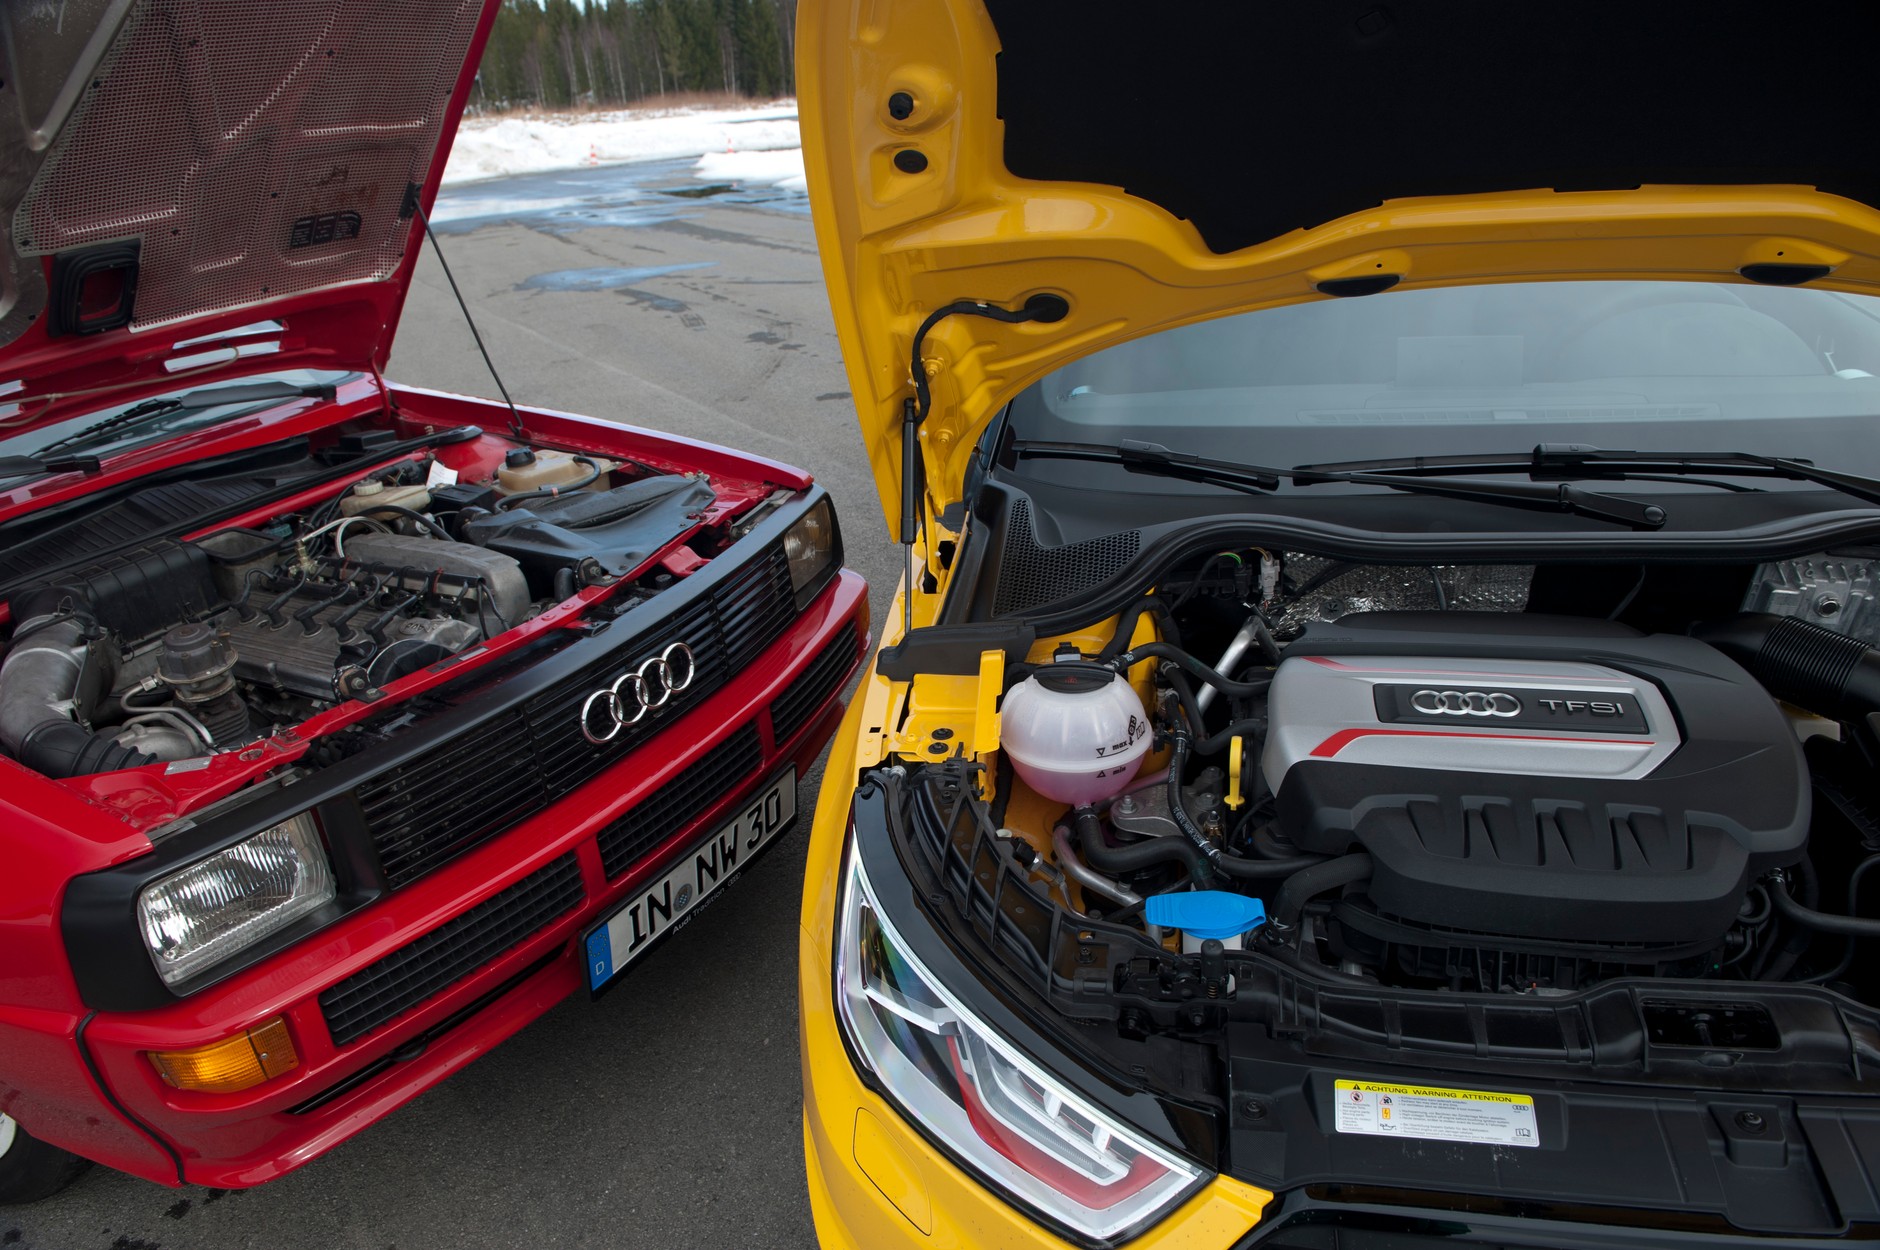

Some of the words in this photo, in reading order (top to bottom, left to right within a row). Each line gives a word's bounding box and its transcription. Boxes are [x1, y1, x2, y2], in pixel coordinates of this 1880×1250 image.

[1539, 699, 1624, 715] TFSI
[1112, 741, 1128, 750] max
[1112, 766, 1126, 775] min
[628, 880, 672, 953] IN
[695, 823, 738, 895] NW
[746, 787, 781, 850] 30
[672, 913, 692, 935] Audi
[692, 887, 725, 916] Tradition
[595, 961, 604, 975] D
[1365, 1085, 1408, 1094] ACHTUNG
[1413, 1089, 1457, 1098] WARNING
[1462, 1093, 1512, 1103] ATTENTION
